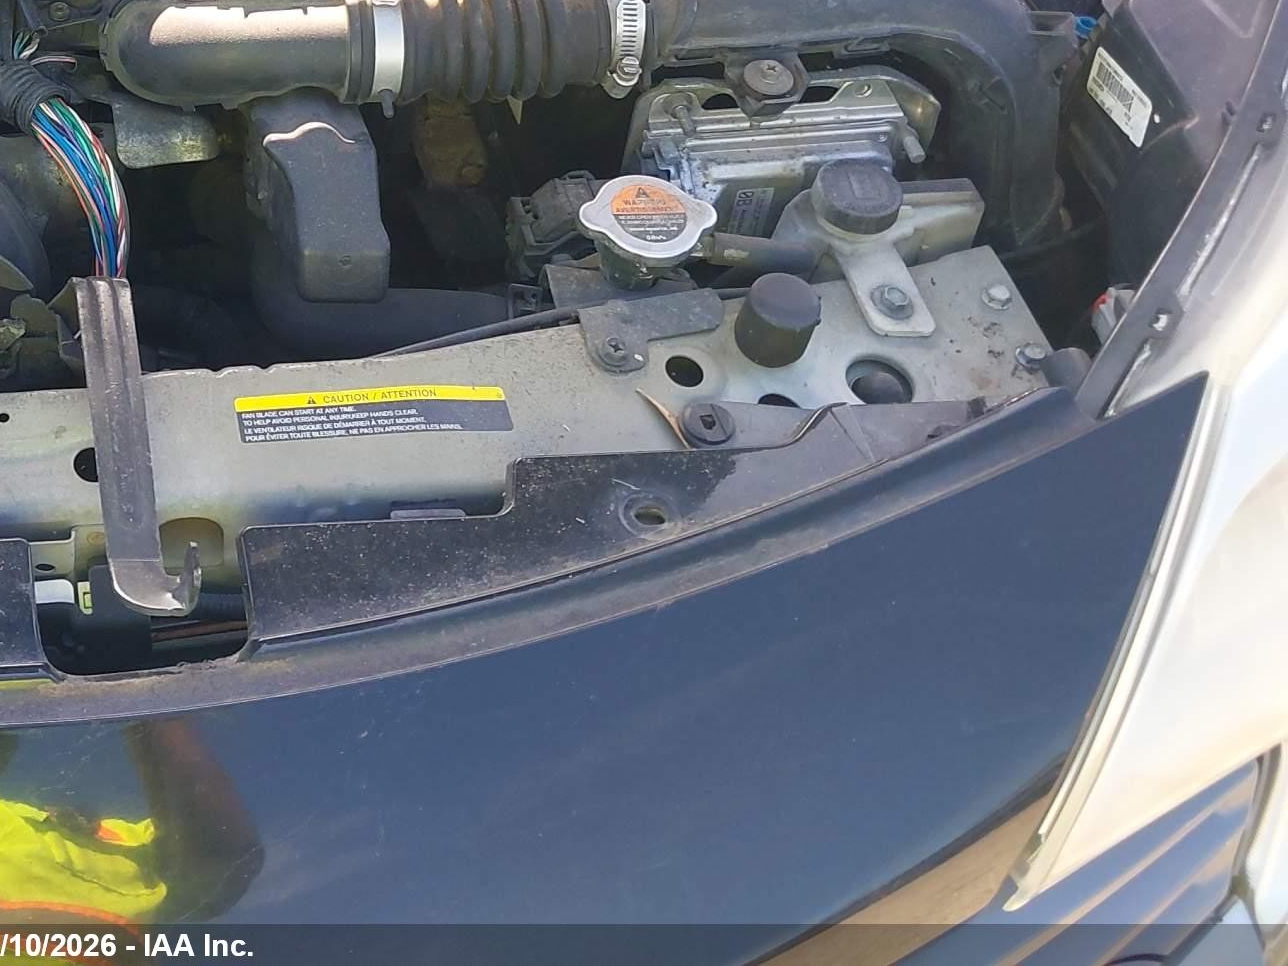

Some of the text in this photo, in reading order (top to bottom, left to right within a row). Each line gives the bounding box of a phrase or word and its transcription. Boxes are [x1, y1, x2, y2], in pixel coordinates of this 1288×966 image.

[323, 393, 369, 404] CAUTION
[381, 390, 437, 400] ATTENTION
[333, 419, 370, 428] DÉMARRER
[266, 433, 289, 441] ÉVITER
